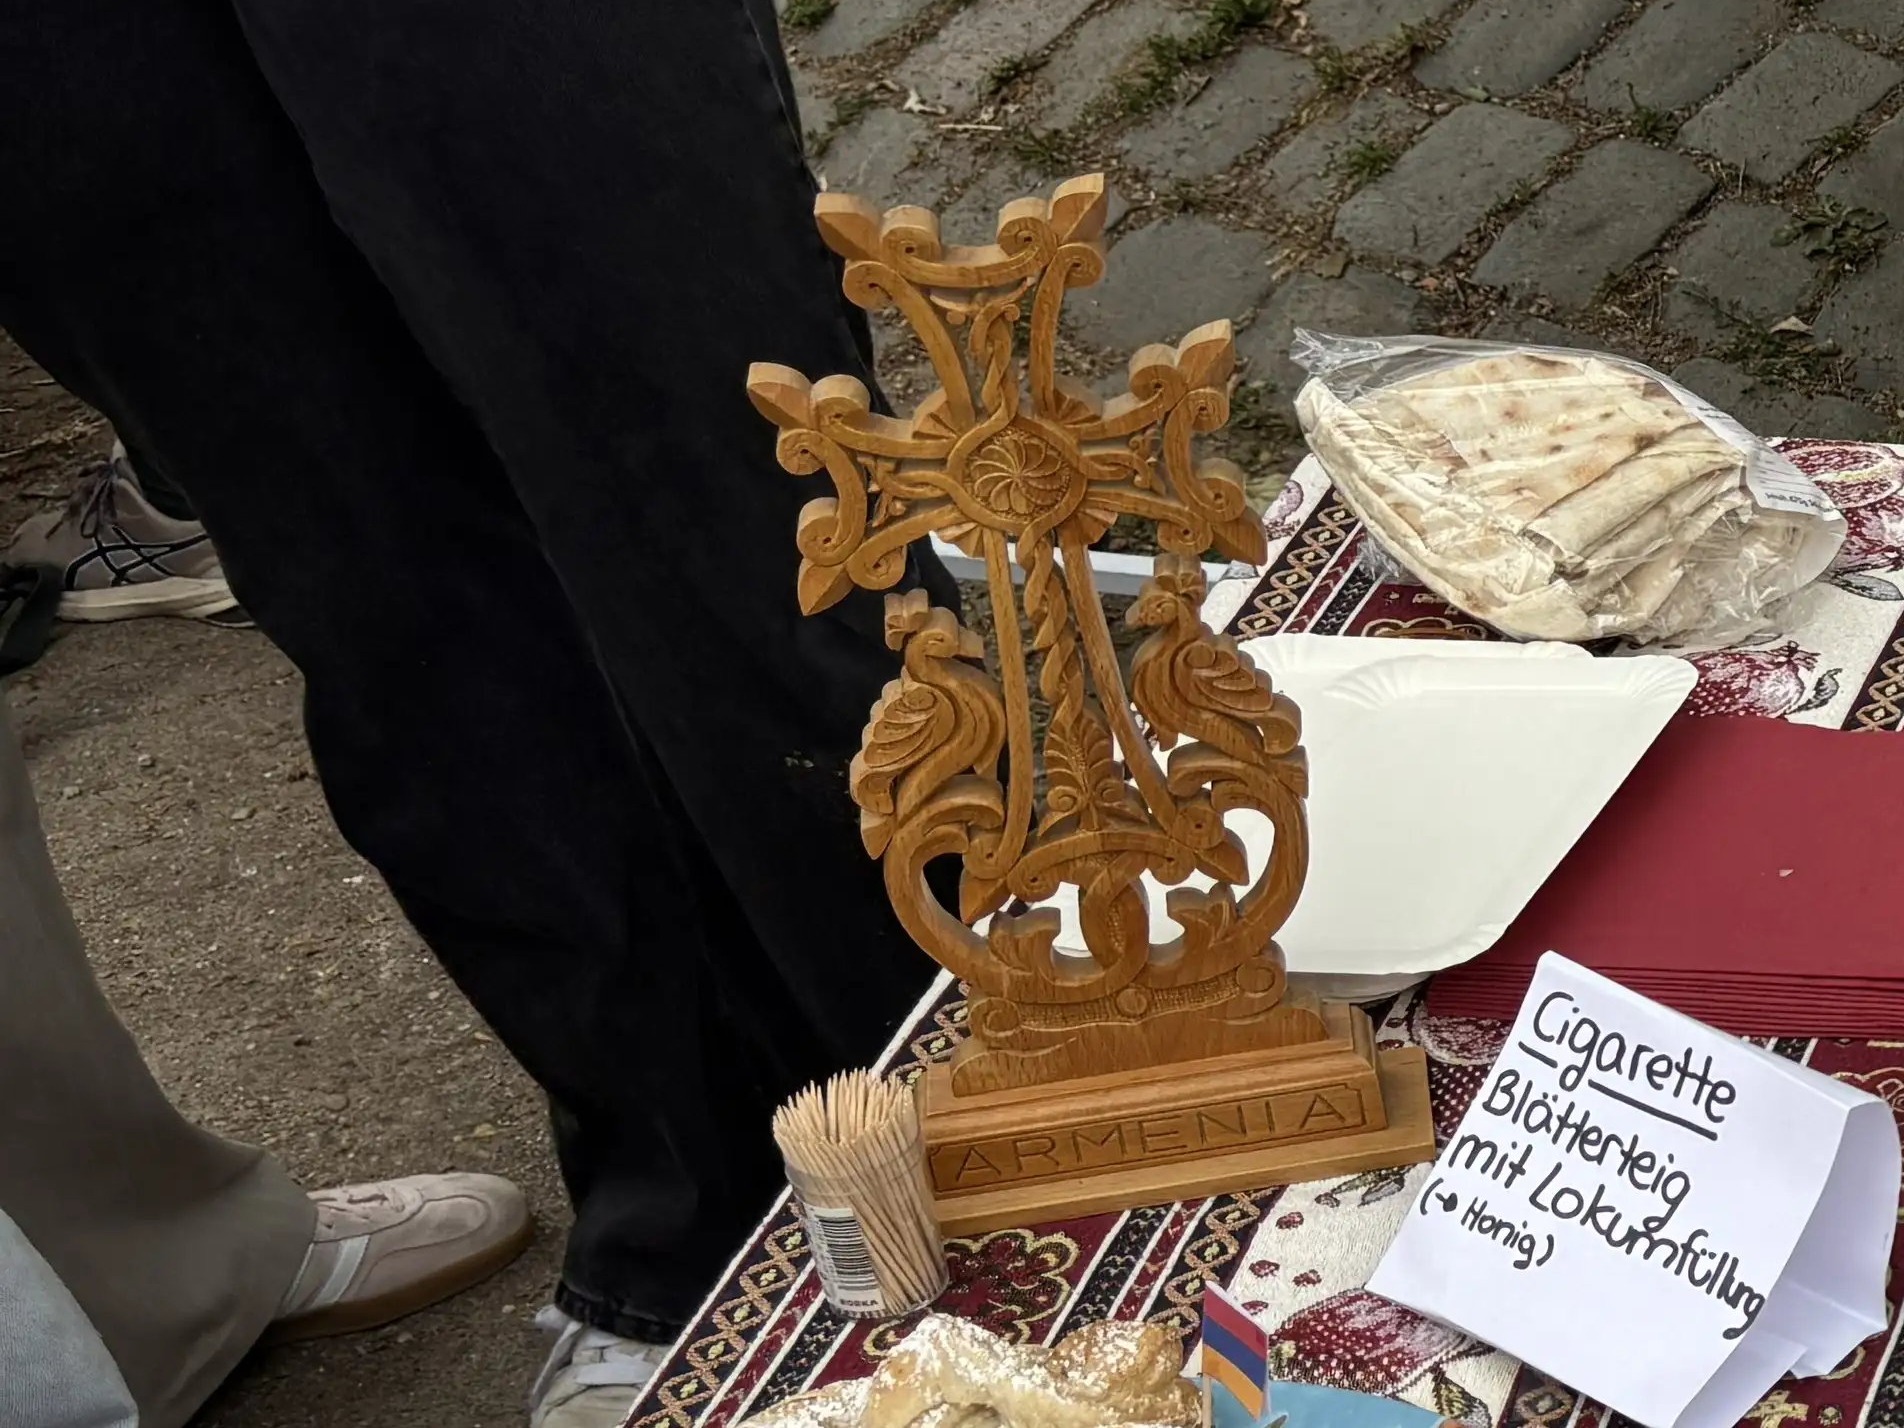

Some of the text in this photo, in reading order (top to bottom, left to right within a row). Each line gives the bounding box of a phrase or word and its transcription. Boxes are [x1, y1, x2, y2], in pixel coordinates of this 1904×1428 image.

[1533, 992, 1736, 1123] Cigarette
[955, 1093, 1348, 1182] ARMENIA
[1482, 1069, 1691, 1231] Blätterteig
[1449, 1132, 1766, 1340] mit Lokumfüllung
